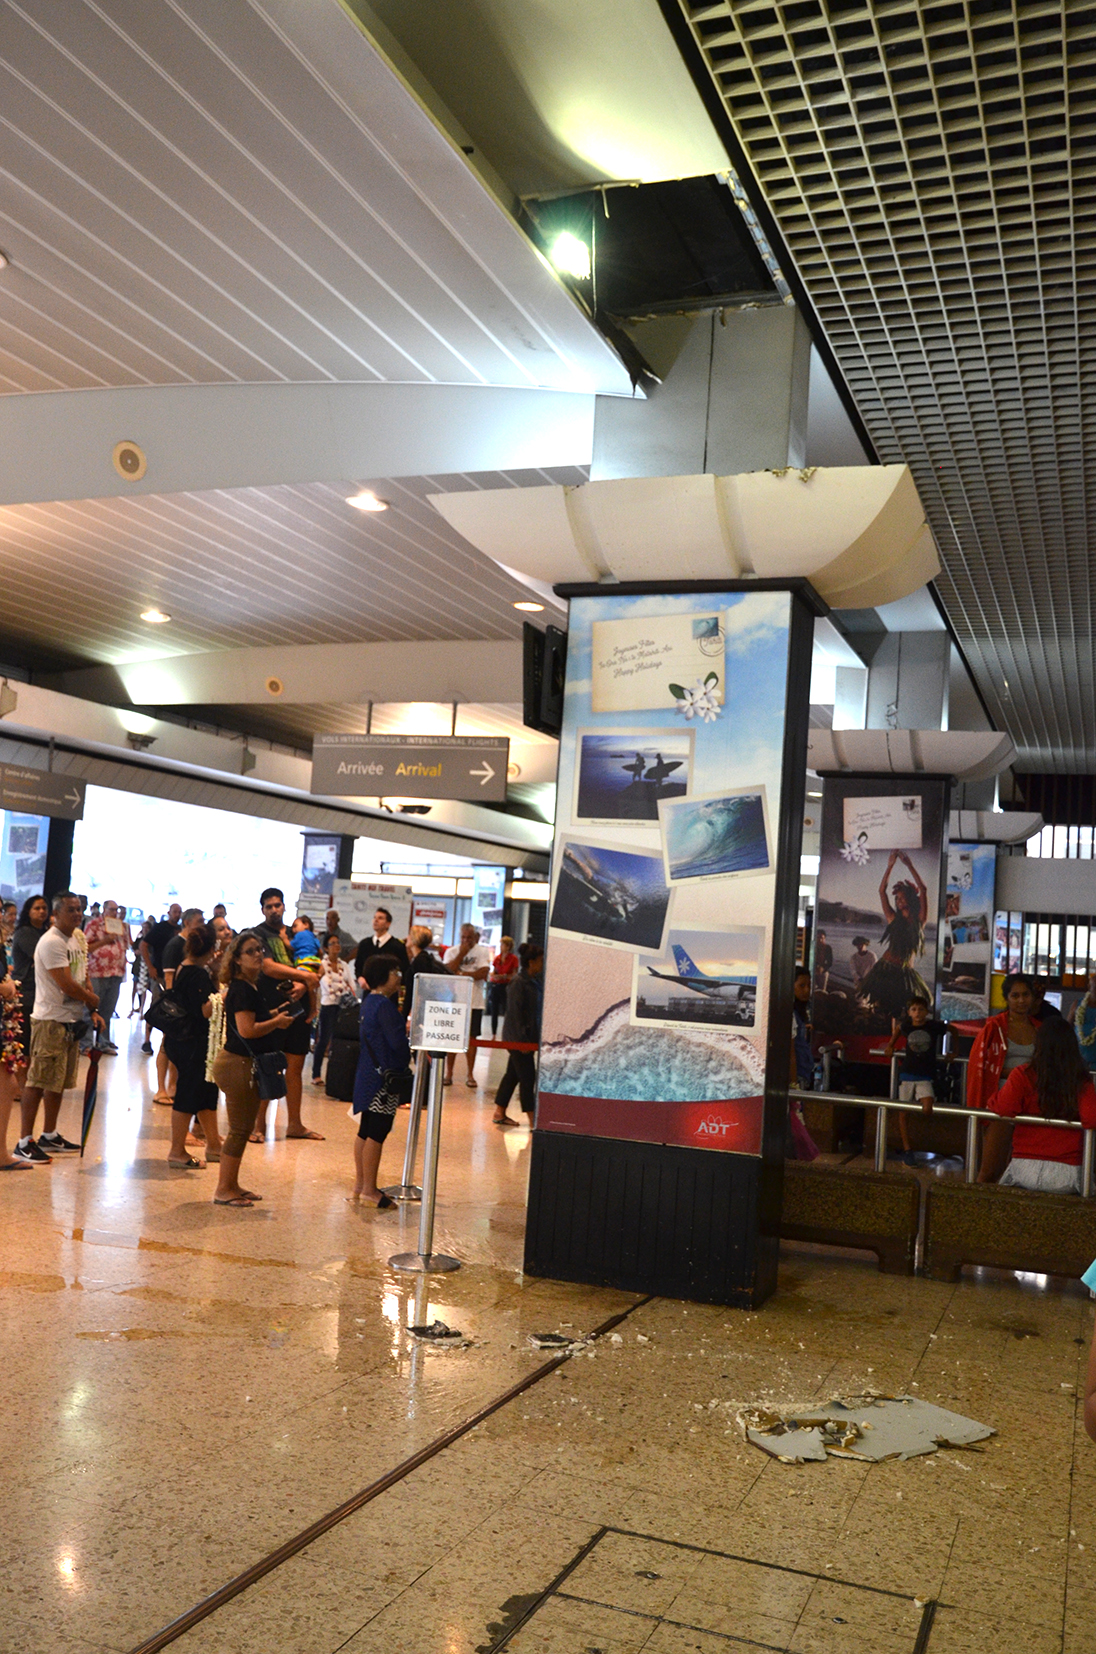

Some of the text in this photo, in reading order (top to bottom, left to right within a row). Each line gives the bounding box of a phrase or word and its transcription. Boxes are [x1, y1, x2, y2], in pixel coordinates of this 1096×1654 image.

[321, 736, 338, 744] VOLS
[337, 761, 384, 776] Arrivée
[395, 762, 442, 777] Arrival
[428, 1006, 462, 1015] ZONE DE
[434, 1019, 455, 1028] LIBRE
[425, 1032, 461, 1041] PASSAGE
[697, 1121, 730, 1135] ADT
